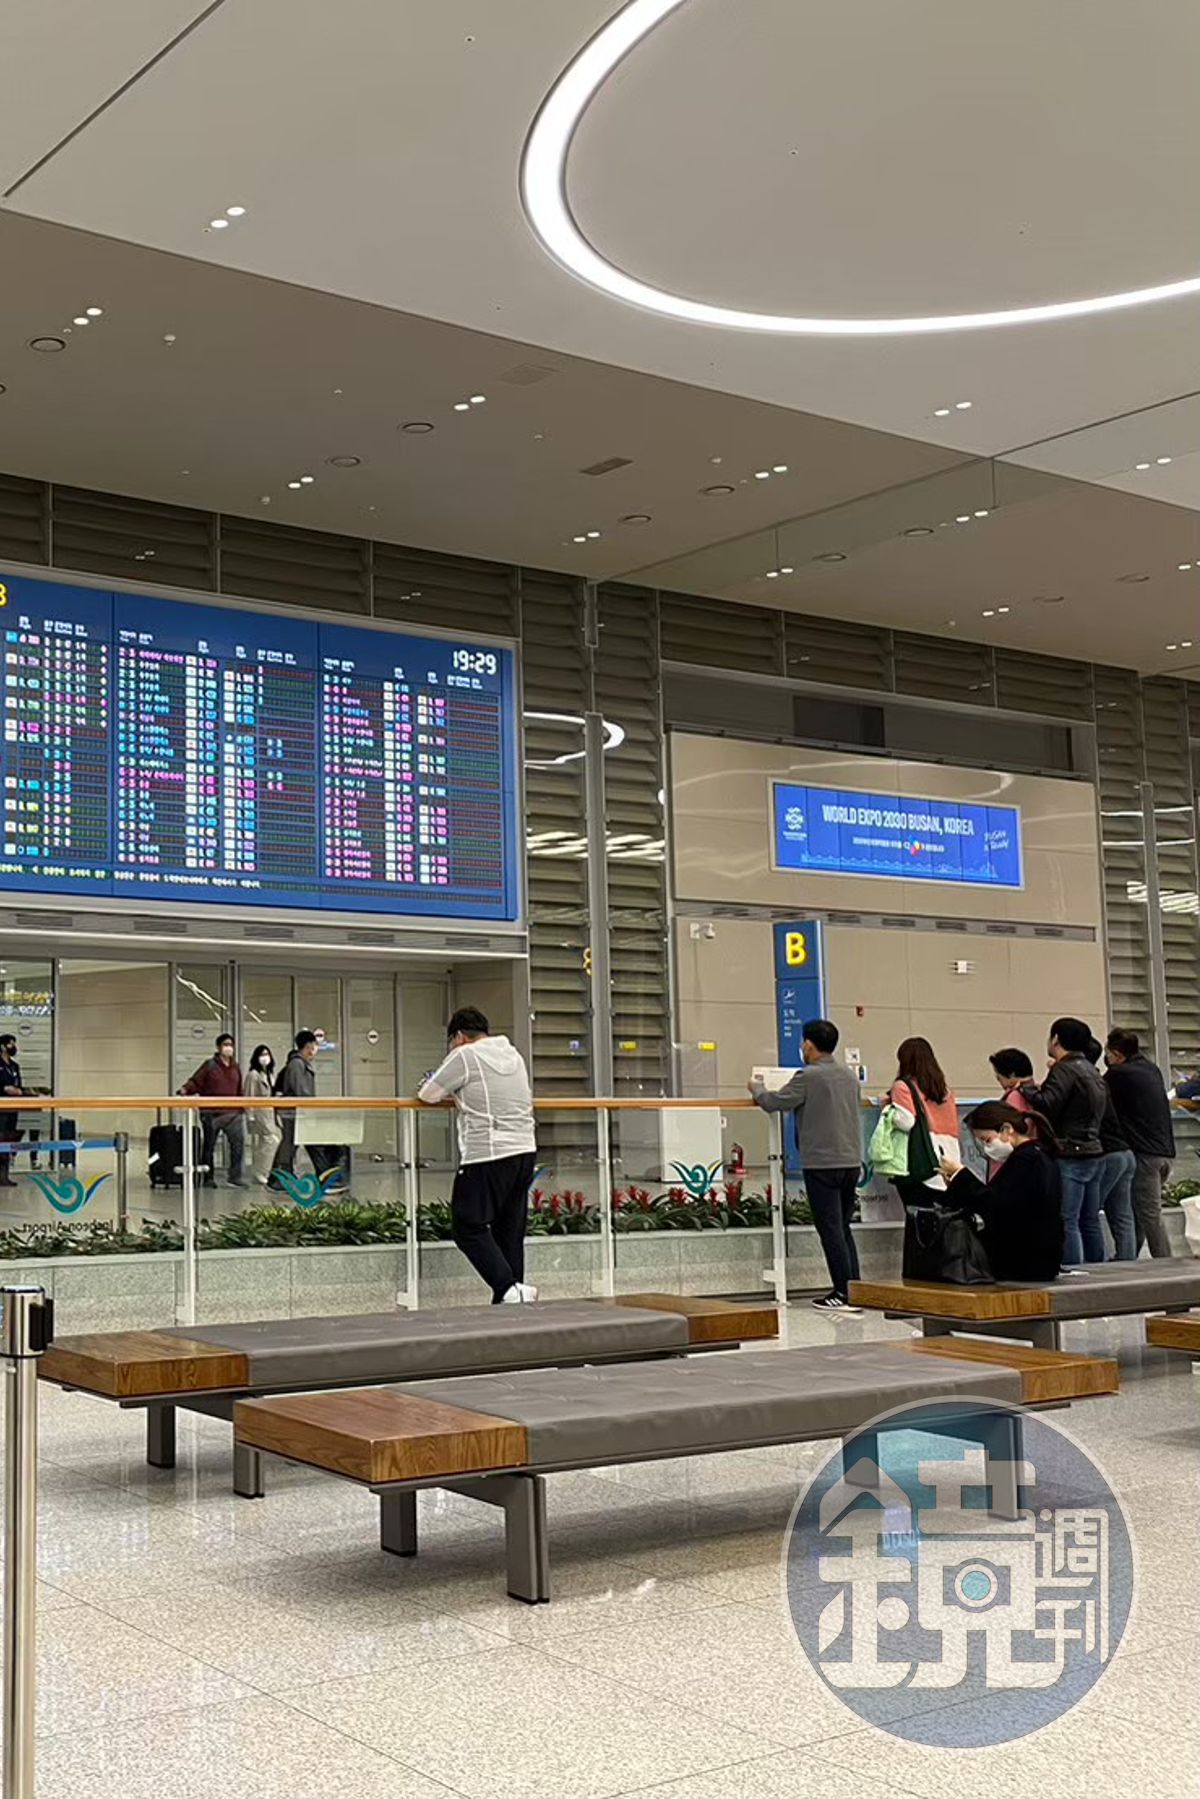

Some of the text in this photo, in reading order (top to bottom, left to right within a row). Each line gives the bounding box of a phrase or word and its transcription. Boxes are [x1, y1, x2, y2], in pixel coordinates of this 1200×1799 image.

[453, 650, 497, 675] 19:29
[822, 804, 857, 824] WORLD
[858, 808, 881, 827] EXPO
[883, 811, 907, 829] 2030
[943, 817, 975, 836] KOREA
[785, 932, 806, 965] B
